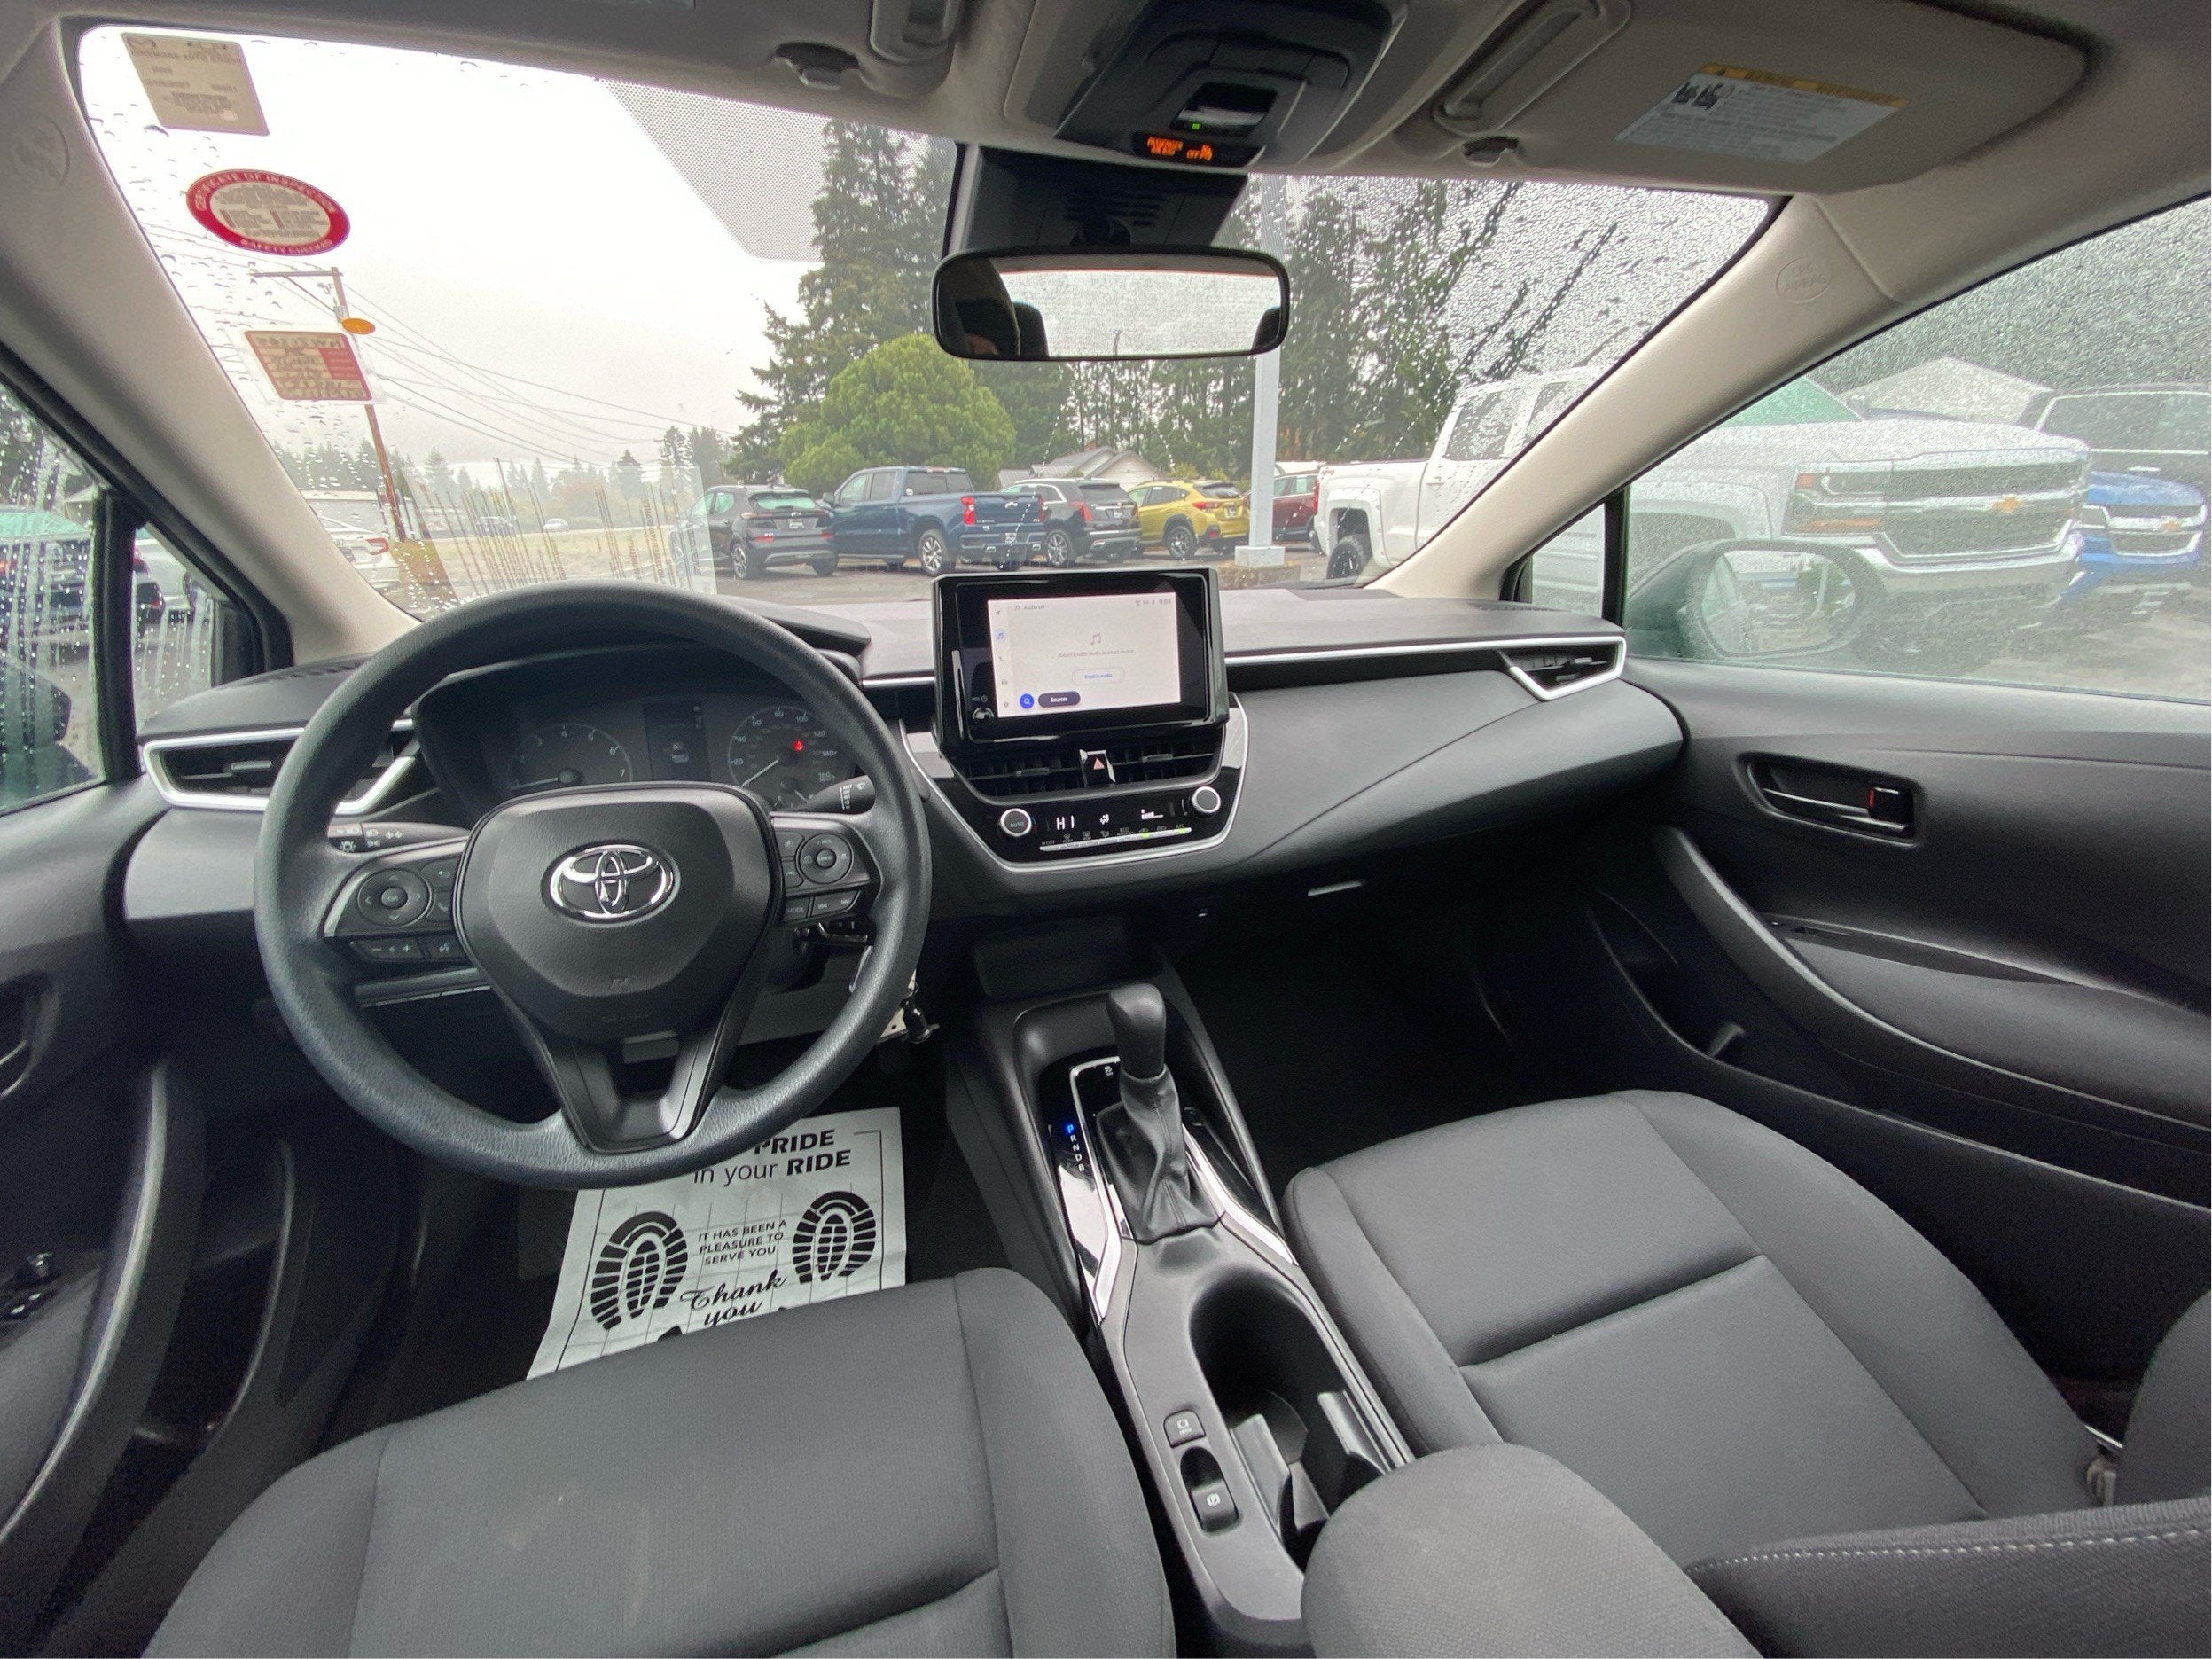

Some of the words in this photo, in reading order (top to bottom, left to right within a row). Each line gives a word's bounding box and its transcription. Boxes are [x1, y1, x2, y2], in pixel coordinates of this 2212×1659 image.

[1056, 815, 1075, 831] HI
[723, 1162, 778, 1188] your
[786, 1149, 852, 1177] RIDE
[699, 1233, 708, 1242] IT
[713, 1227, 739, 1240] HAS
[743, 1221, 775, 1235] BEEN
[778, 1219, 787, 1228] A
[700, 1235, 763, 1255] PLEASURE
[768, 1232, 784, 1243] TO
[705, 1251, 745, 1265] SERVE
[749, 1246, 776, 1258] YOU
[680, 1269, 788, 1311] Thank
[704, 1300, 763, 1326] you
